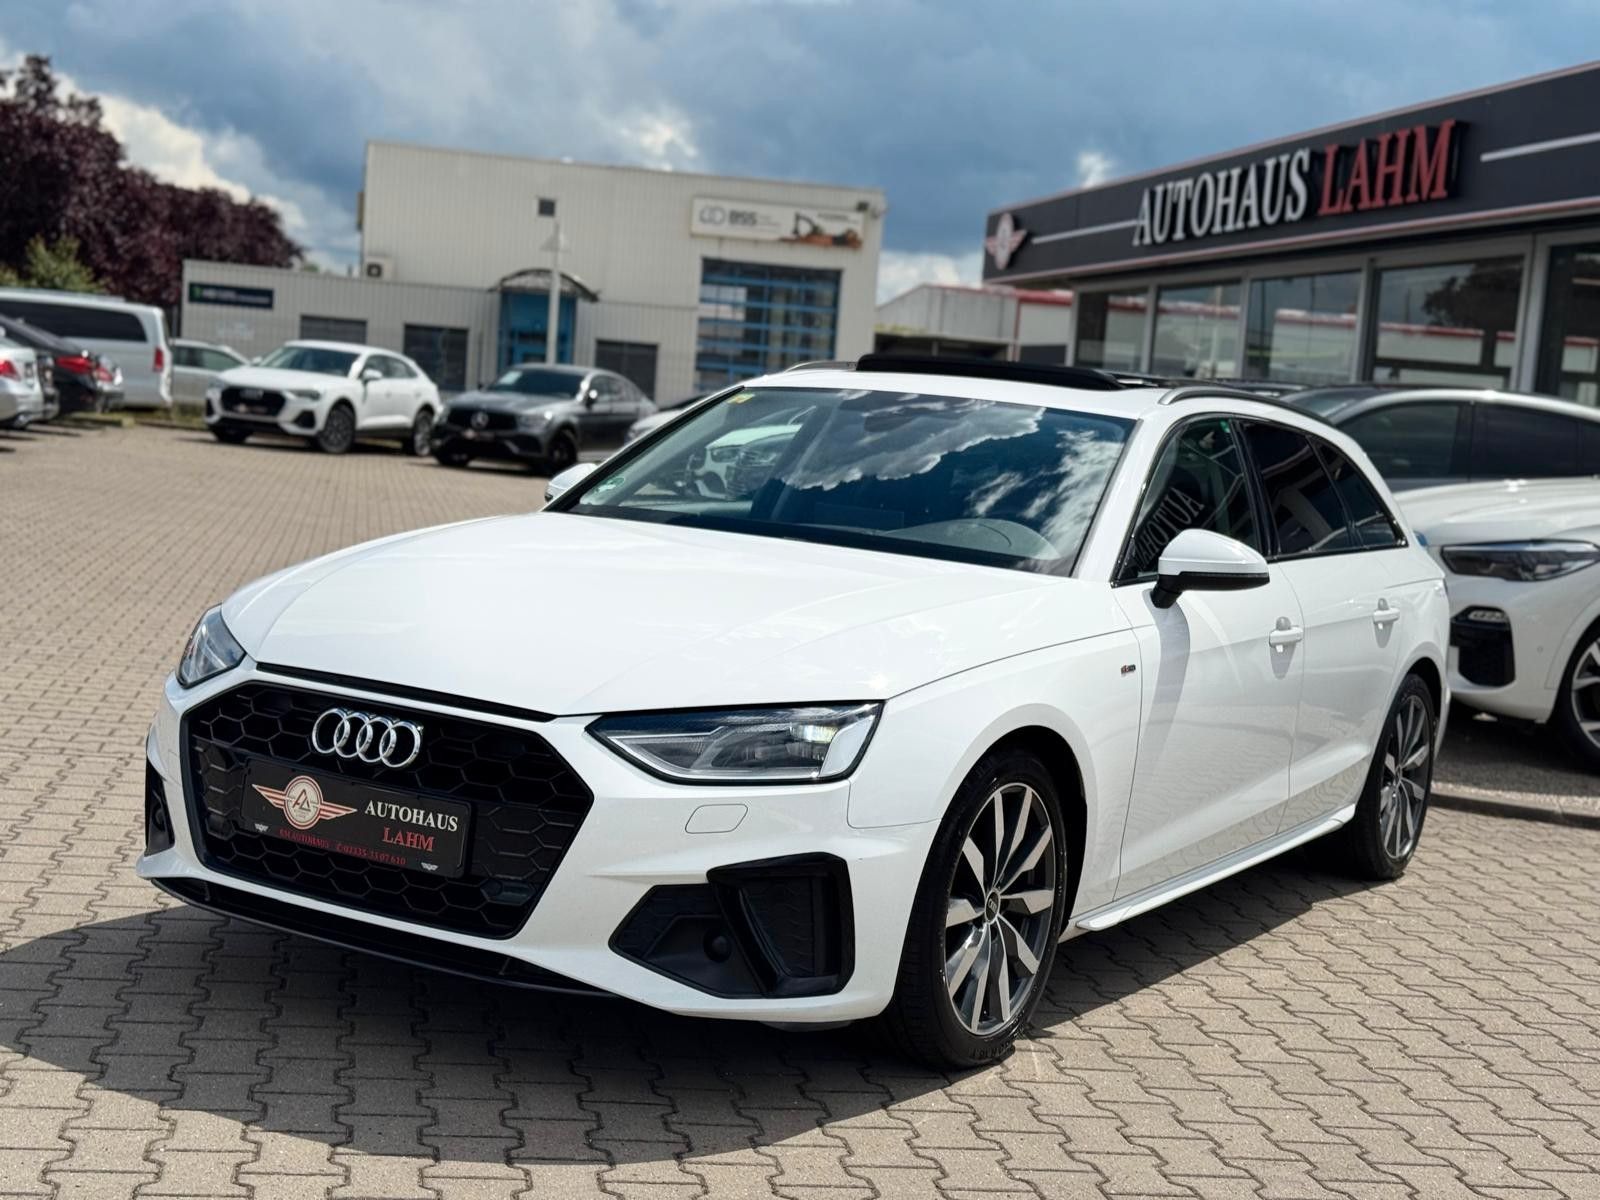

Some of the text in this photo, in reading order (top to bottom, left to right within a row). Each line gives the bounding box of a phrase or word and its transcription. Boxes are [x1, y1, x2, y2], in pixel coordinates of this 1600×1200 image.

[1132, 119, 1456, 246] AUTOHAUS LAHM
[365, 800, 458, 832] AUTOHAUS
[382, 826, 434, 852] LAHM
